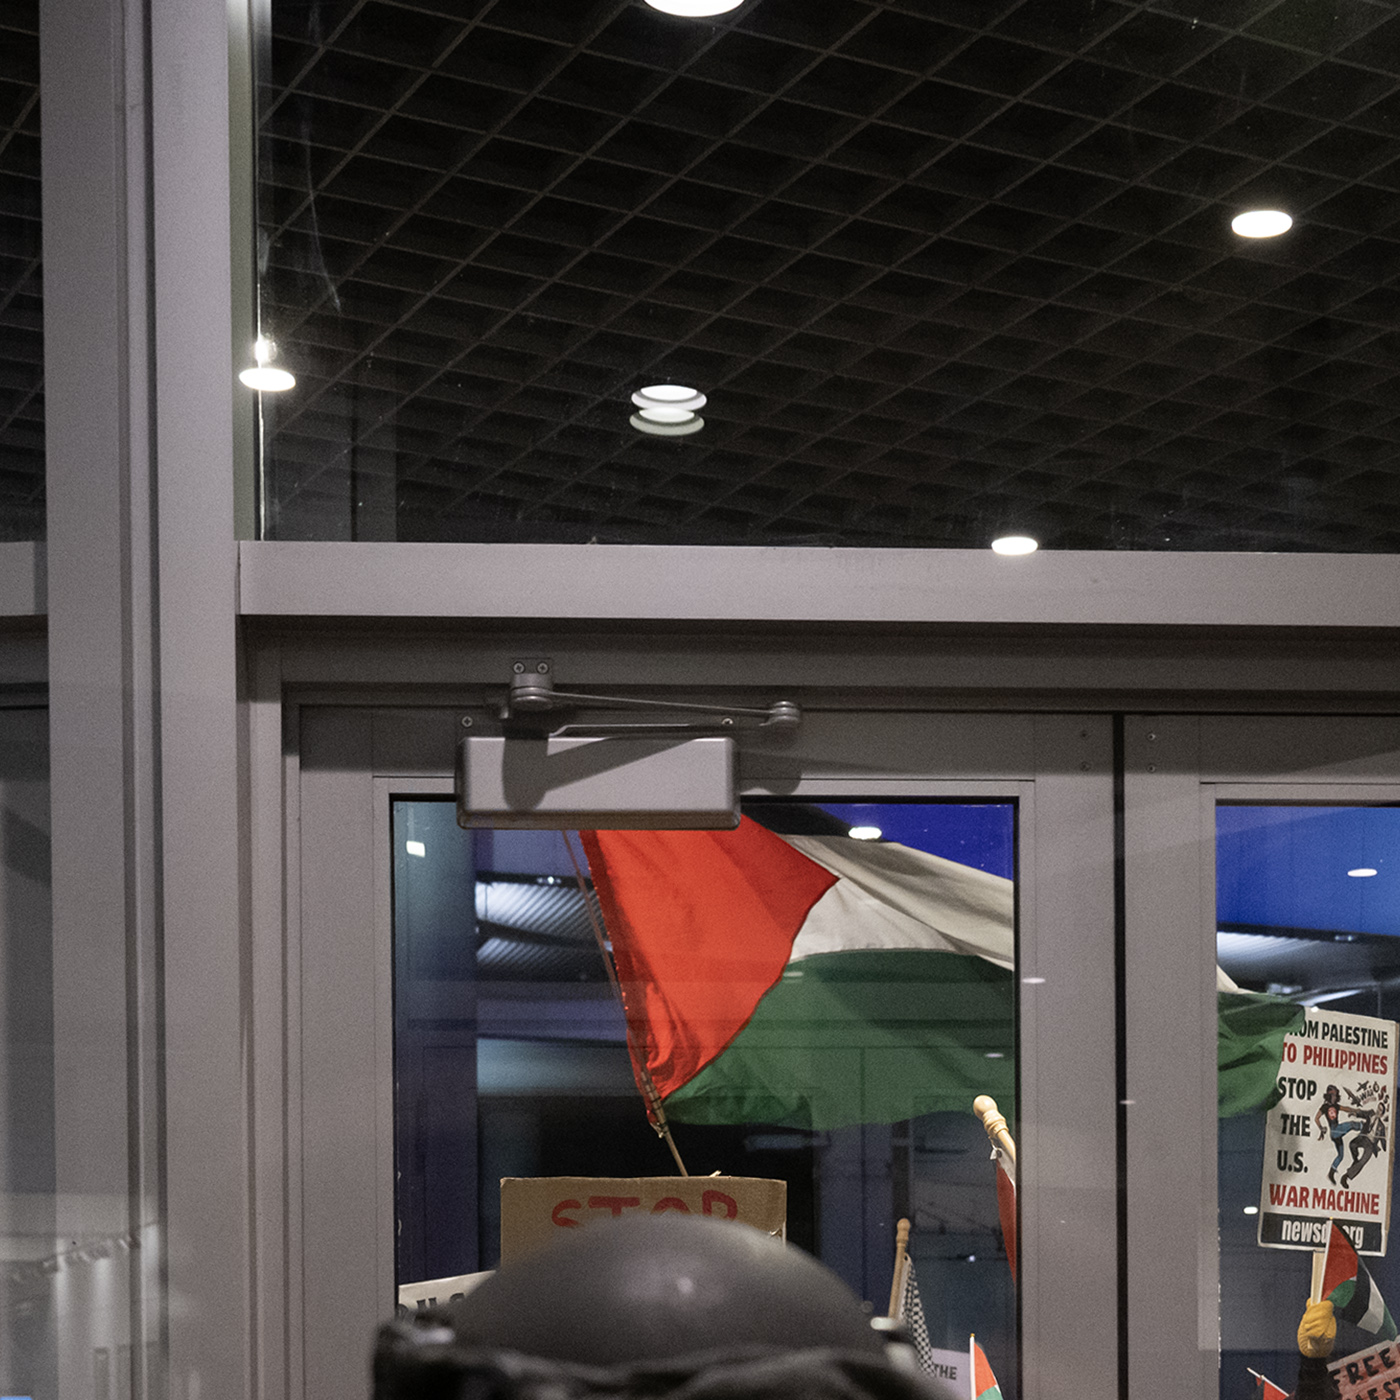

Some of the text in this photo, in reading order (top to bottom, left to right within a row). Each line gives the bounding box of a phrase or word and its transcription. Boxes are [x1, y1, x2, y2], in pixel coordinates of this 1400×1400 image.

[1322, 1023, 1388, 1049] PALESTINE
[1282, 1042, 1387, 1075] TO PHILIPPINES
[1278, 1076, 1317, 1101] STOP
[1281, 1114, 1310, 1137] THE
[1277, 1150, 1308, 1173] U.S.
[1270, 1184, 1380, 1215] WAR MACHINE
[1328, 1347, 1396, 1389] FREE
